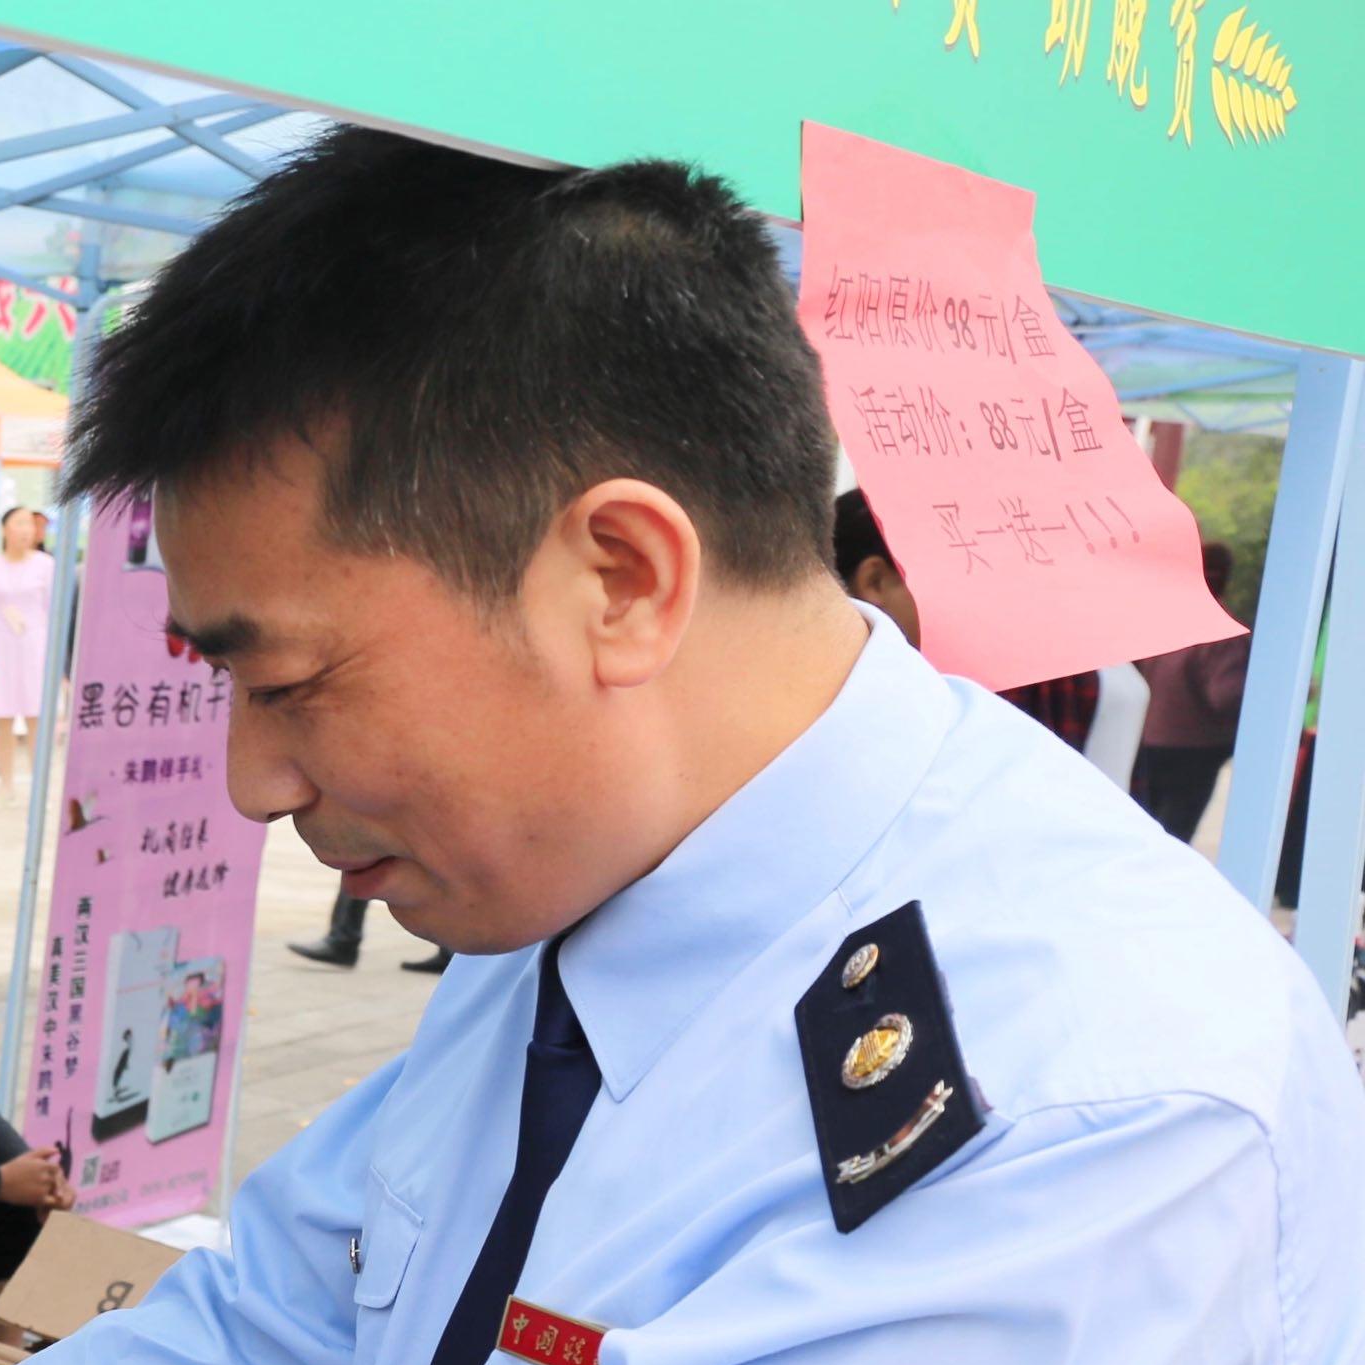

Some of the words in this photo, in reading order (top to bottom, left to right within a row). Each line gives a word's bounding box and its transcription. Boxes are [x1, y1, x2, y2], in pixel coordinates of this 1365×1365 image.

[824, 264, 1056, 365] 红阳原价98元/盒
